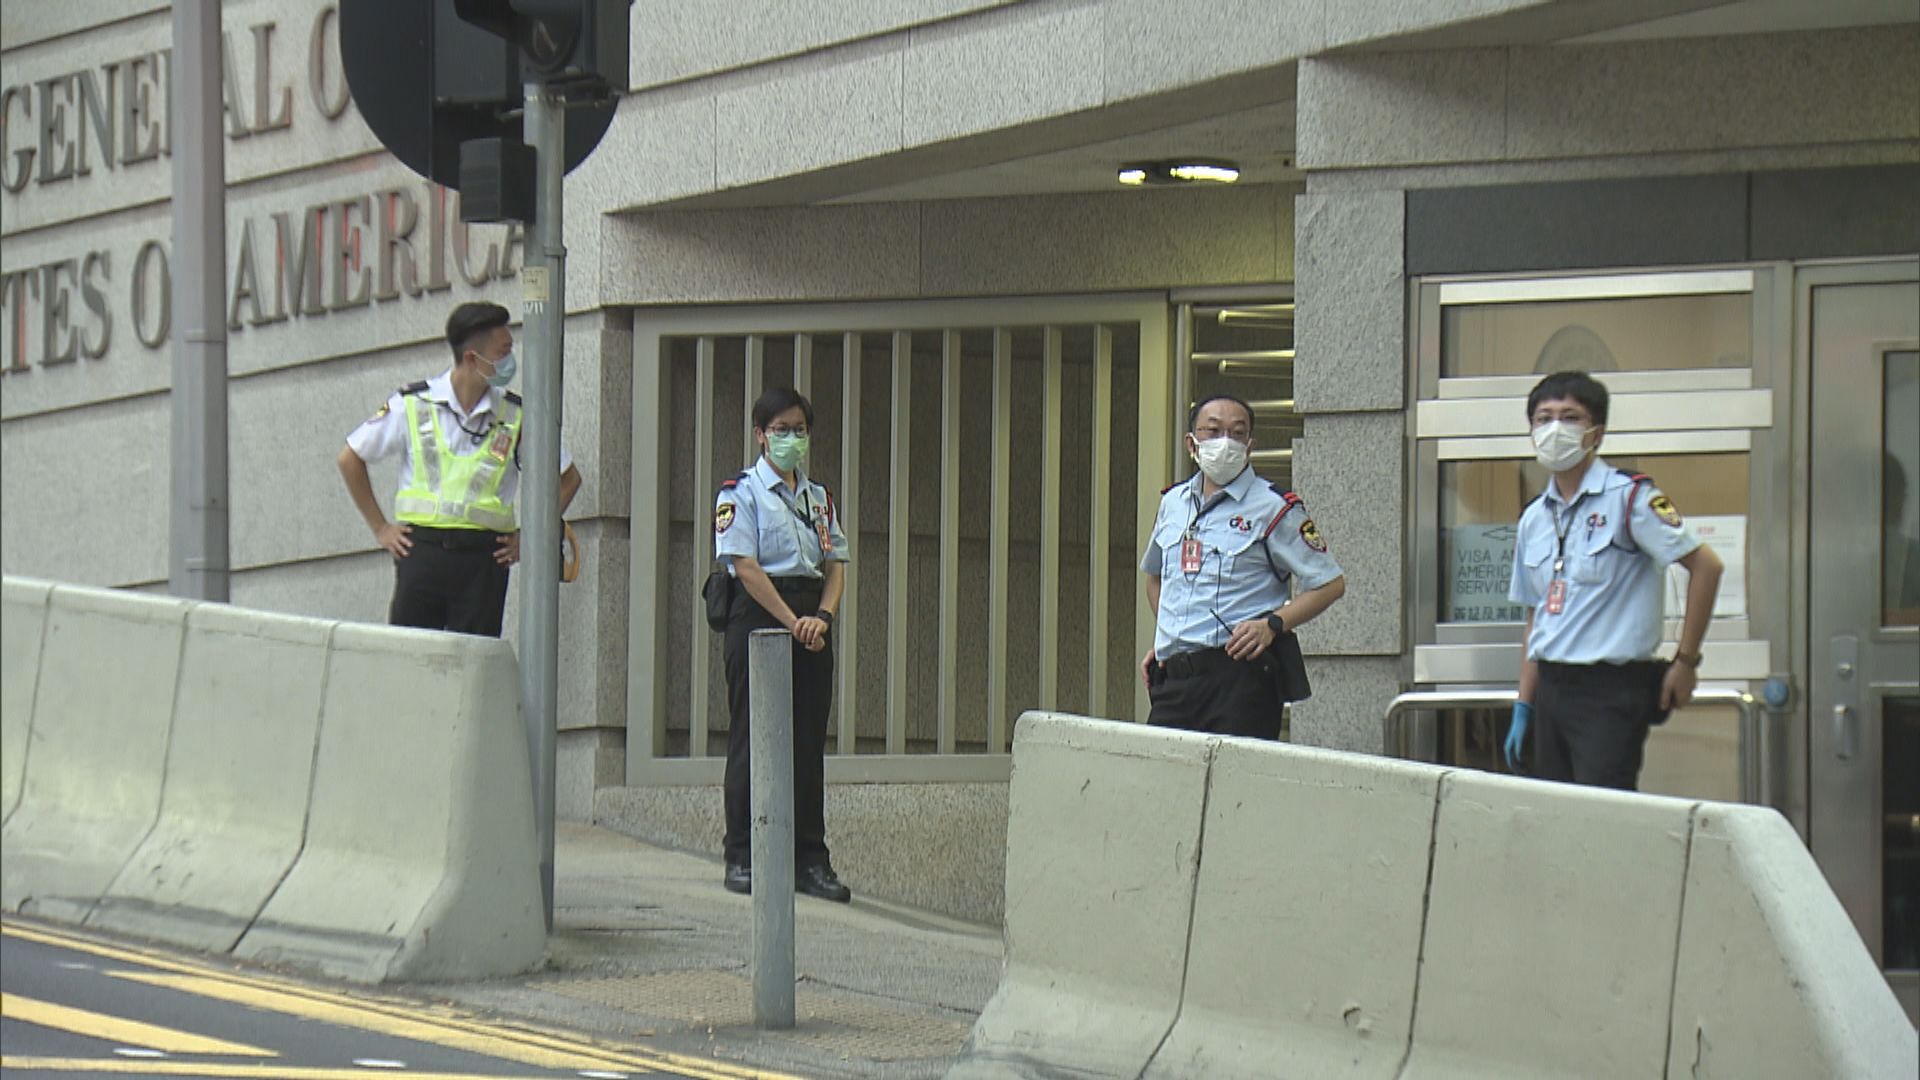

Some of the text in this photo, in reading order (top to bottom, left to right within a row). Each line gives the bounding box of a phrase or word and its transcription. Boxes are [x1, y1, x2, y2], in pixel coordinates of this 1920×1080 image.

[308, 5, 348, 121] O
[1, 239, 172, 378] TES O
[1457, 549, 1491, 563] VISA
[1457, 564, 1512, 579] AMERIC
[1456, 580, 1511, 595] SERVIC
